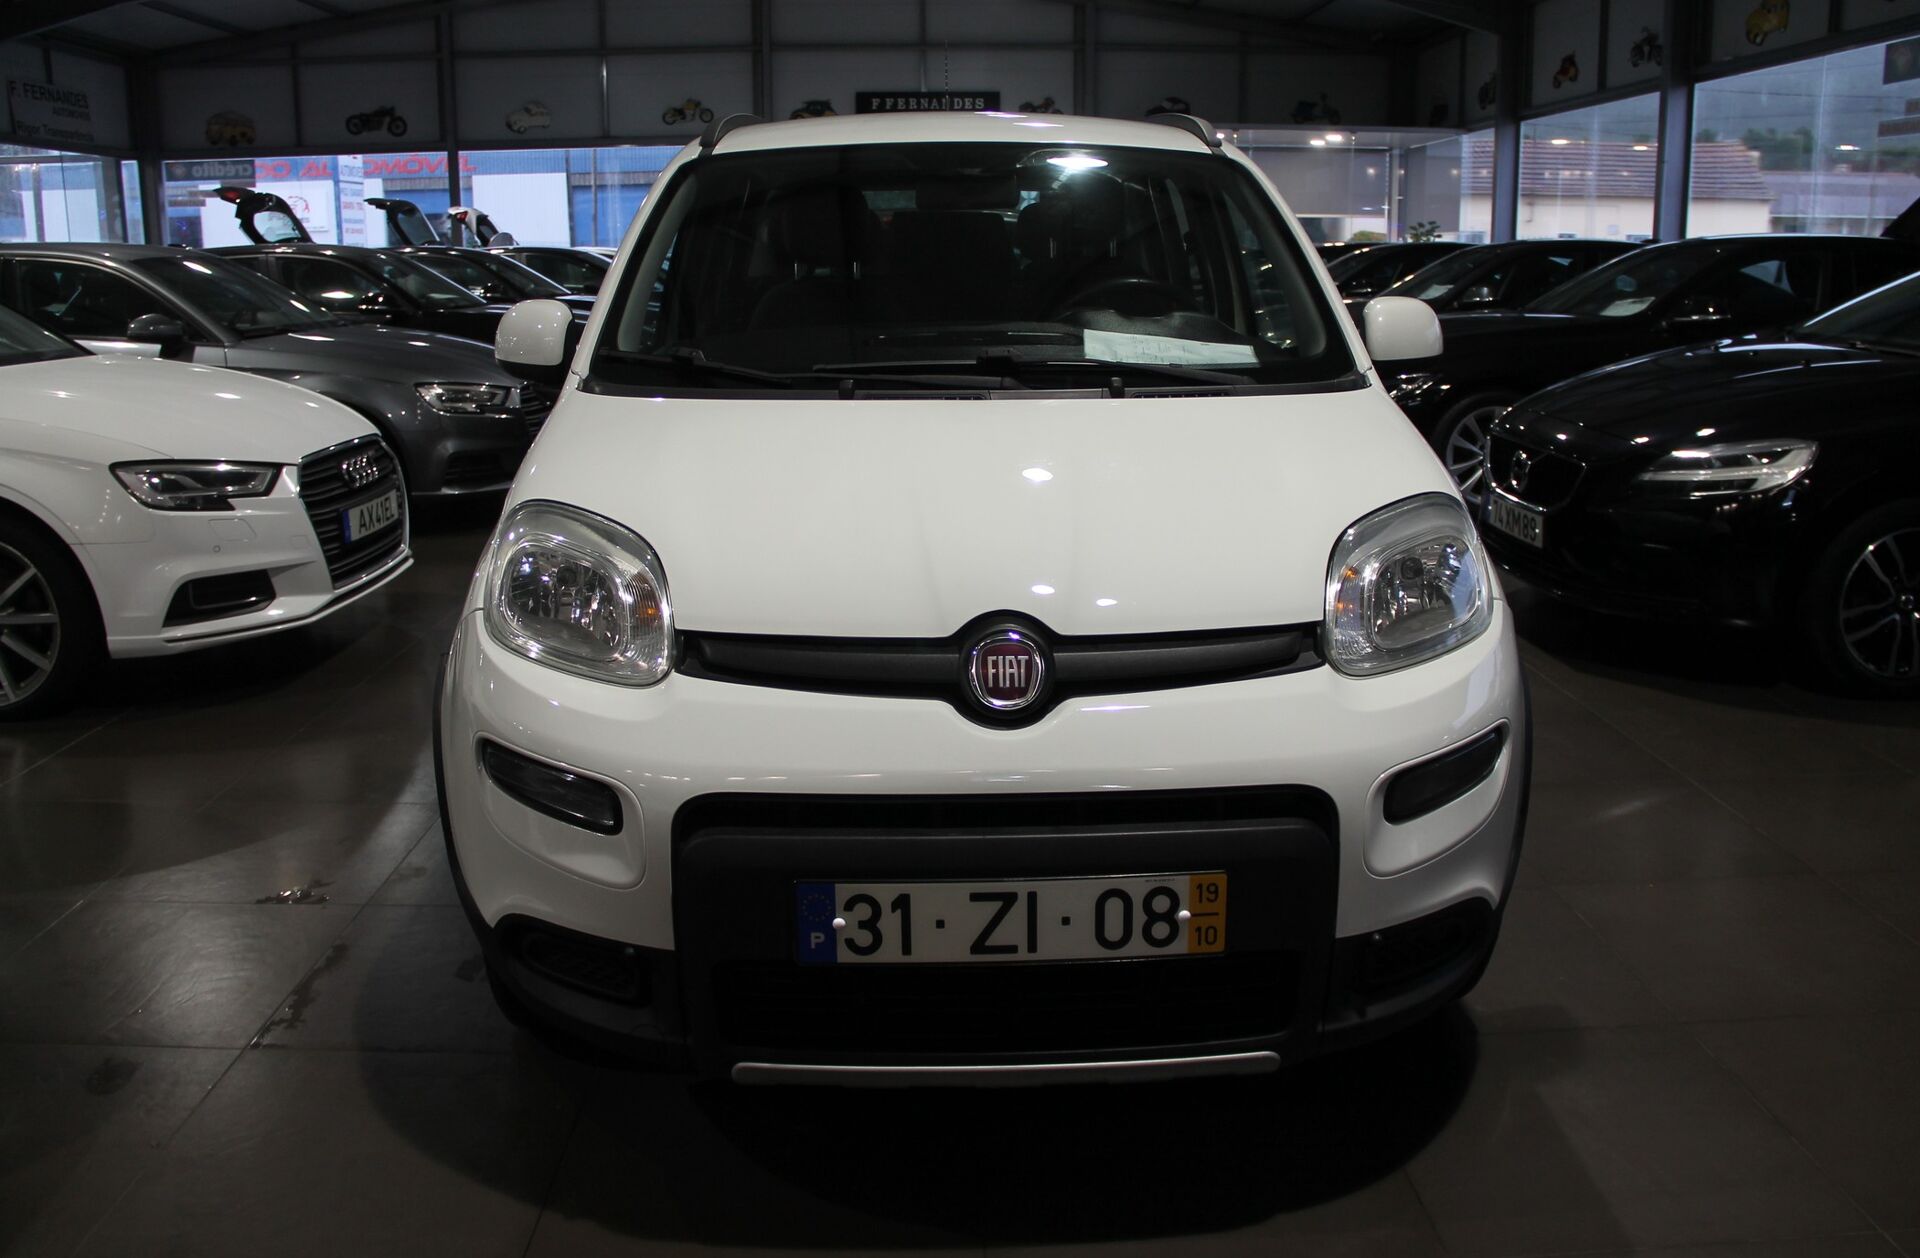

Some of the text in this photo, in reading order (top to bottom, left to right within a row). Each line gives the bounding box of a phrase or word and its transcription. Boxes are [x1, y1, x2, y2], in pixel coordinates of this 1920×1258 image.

[23, 82, 89, 109] FERNANDES
[987, 655, 1029, 688] FIAT
[1196, 882, 1220, 903] 19
[810, 932, 825, 949] P
[1195, 925, 1218, 946] 10
